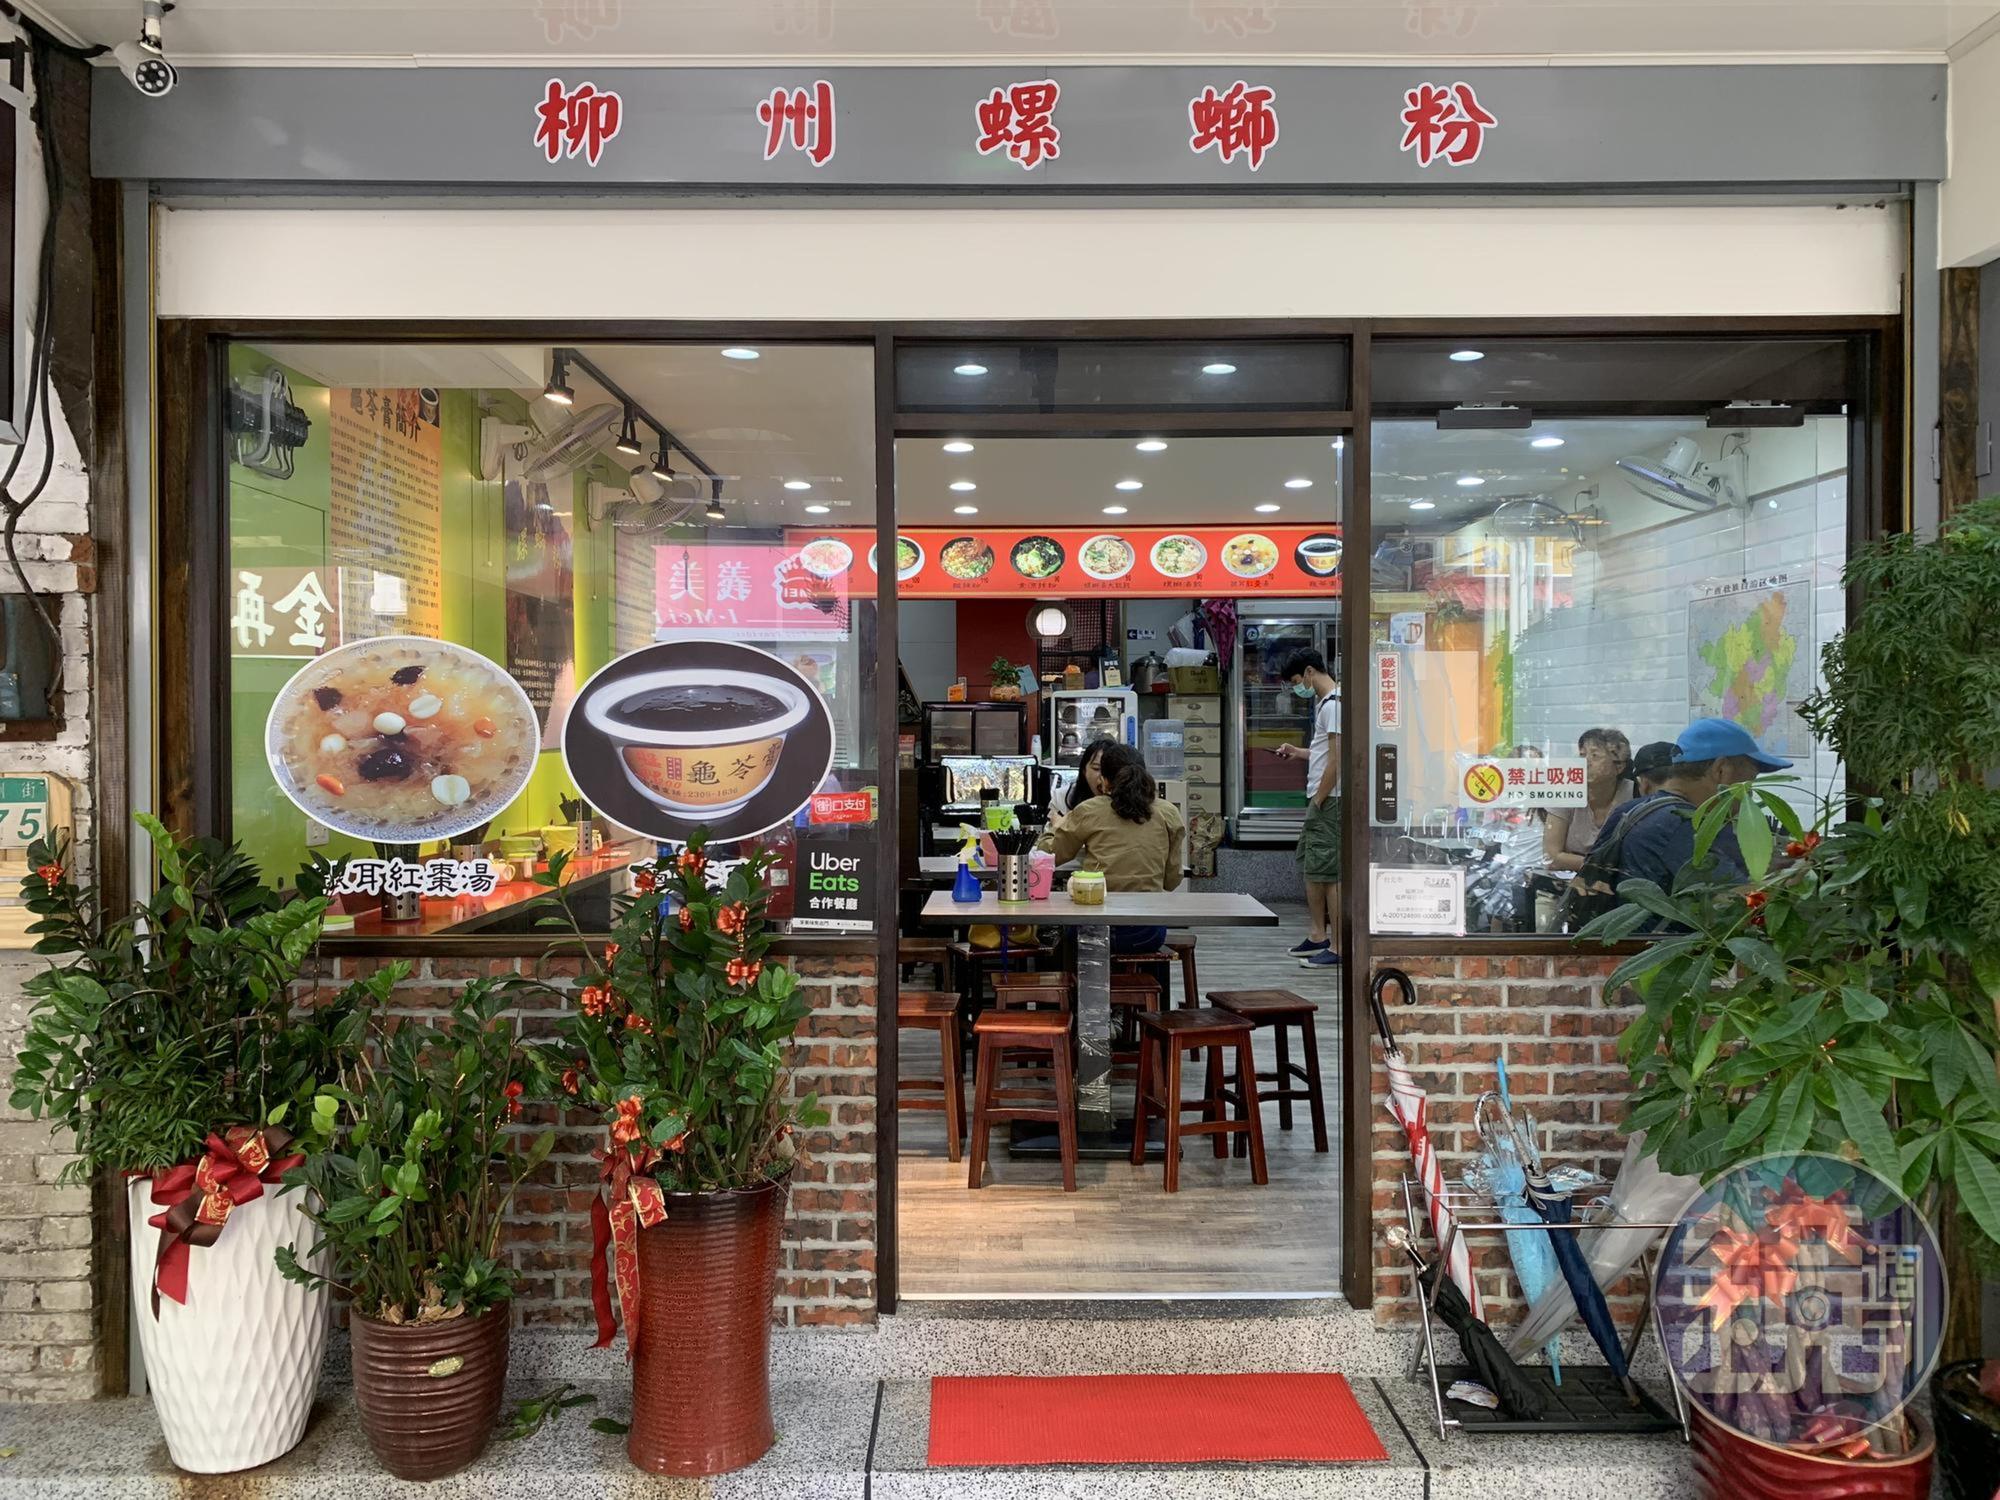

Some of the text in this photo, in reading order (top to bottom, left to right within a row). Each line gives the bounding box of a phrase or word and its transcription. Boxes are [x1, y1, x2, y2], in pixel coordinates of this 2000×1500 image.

[532, 78, 1499, 169] 柳州螺螄粉
[1380, 657, 1397, 723] 錄影中請微笑
[1507, 767, 1584, 786] 禁止吸烟
[1529, 791, 1584, 799] SMOKING
[810, 852, 861, 872] Uber
[809, 872, 860, 892] Eats
[809, 896, 859, 910] 合作餐廳
